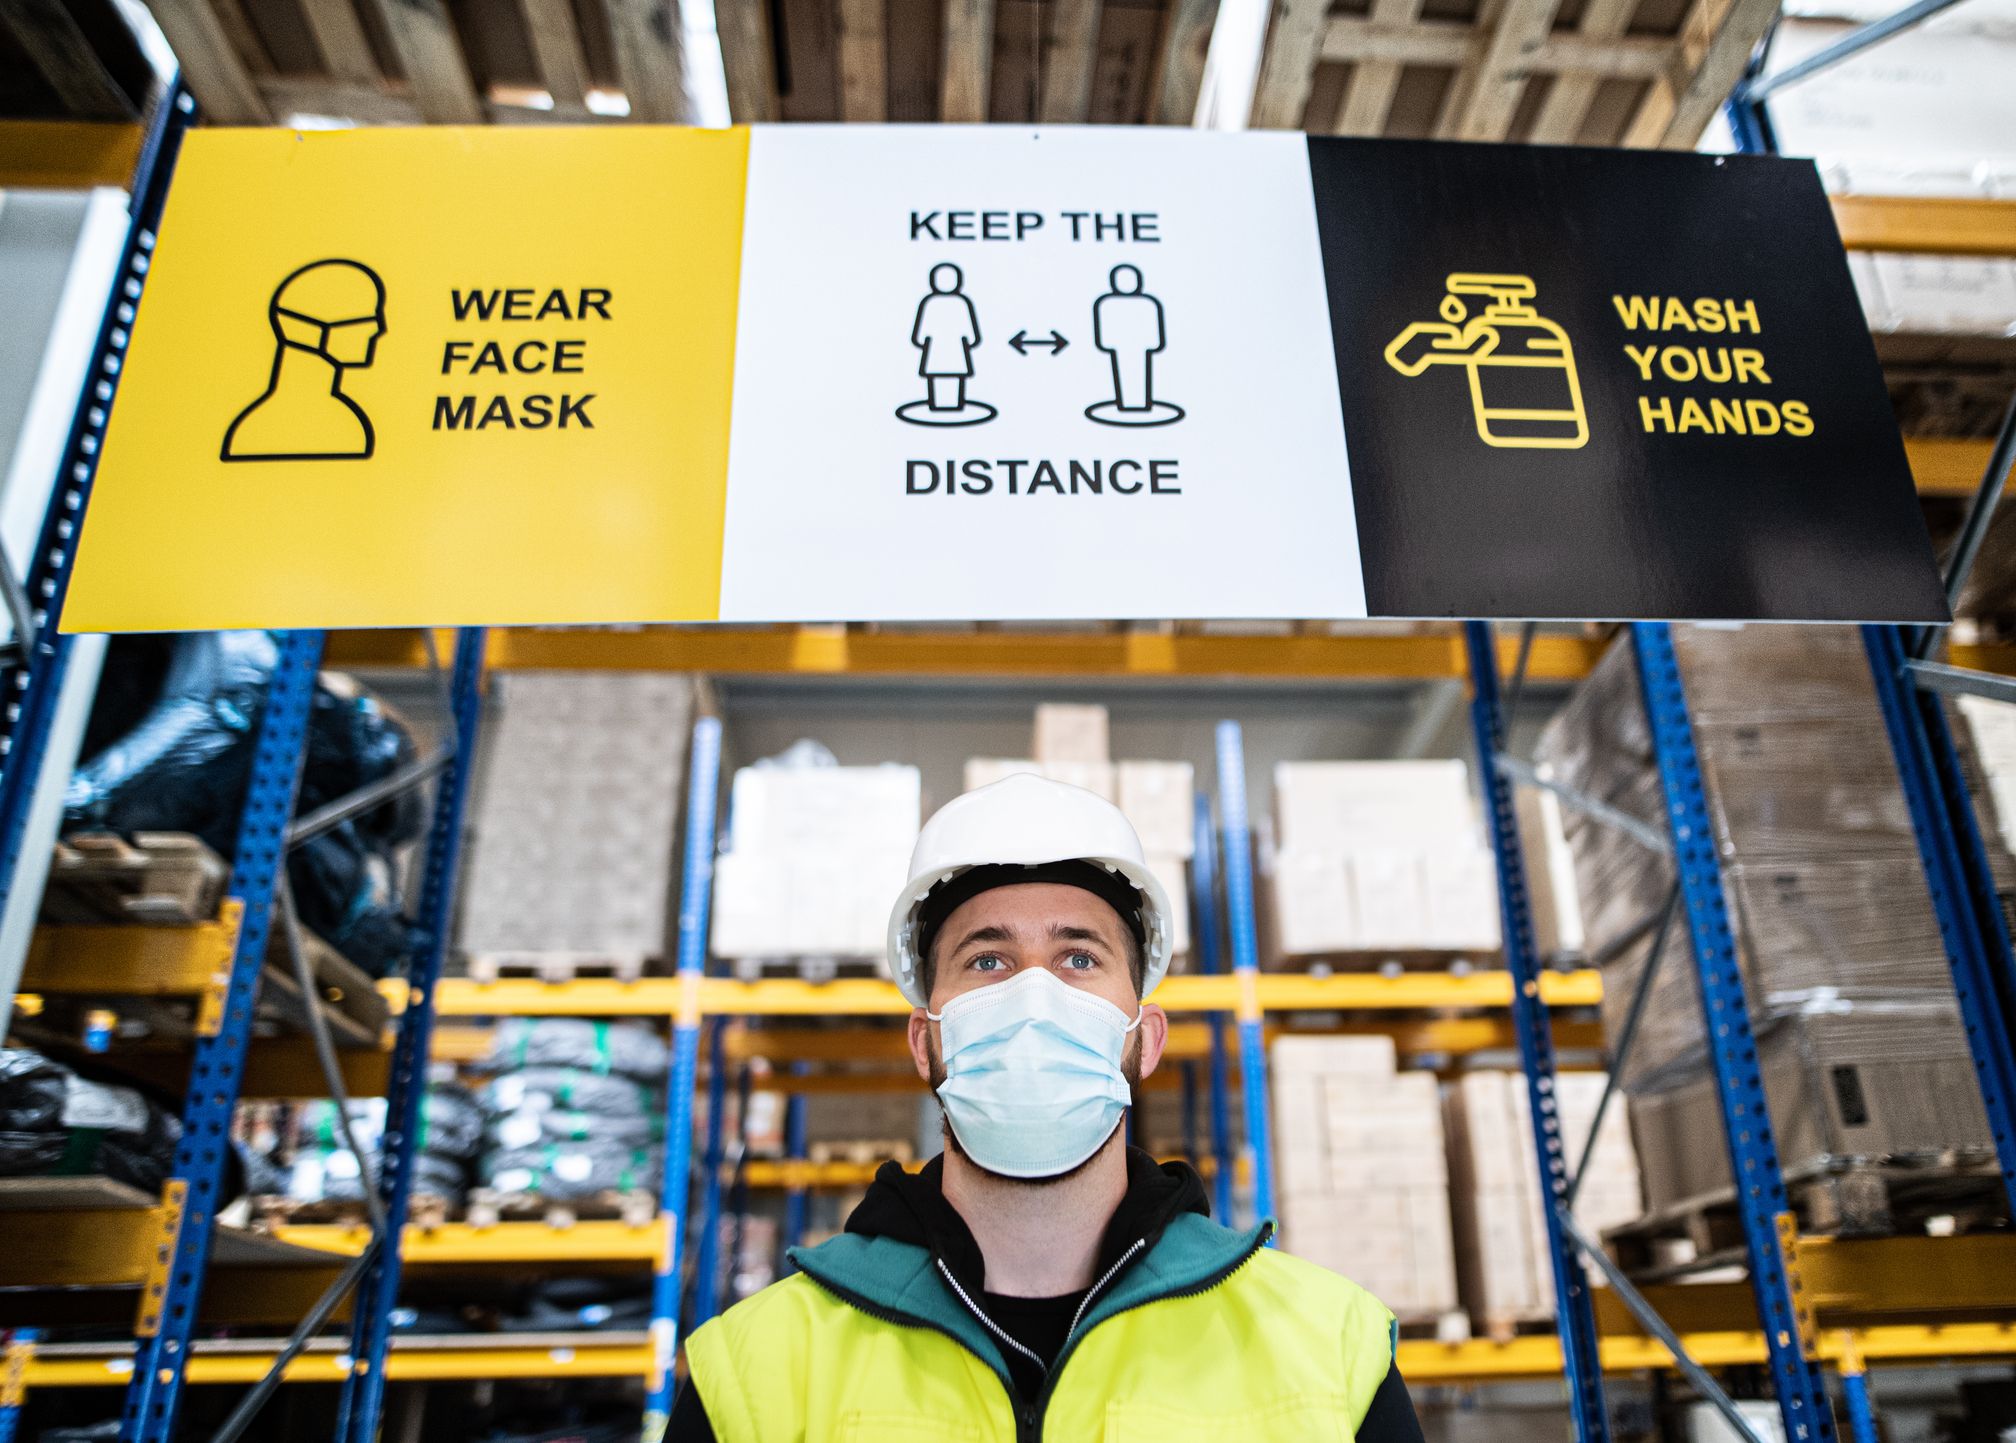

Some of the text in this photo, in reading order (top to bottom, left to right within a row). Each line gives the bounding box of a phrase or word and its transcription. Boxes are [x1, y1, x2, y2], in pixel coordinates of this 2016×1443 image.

[910, 212, 1160, 243] KEEP THE
[450, 288, 612, 321] WEAR
[1612, 295, 1761, 335] WASH
[440, 340, 586, 375] FACE
[1623, 344, 1772, 384] YOUR
[432, 394, 598, 430] MASK
[1638, 397, 1815, 437] HANDS
[906, 459, 1181, 495] DISTANCE
